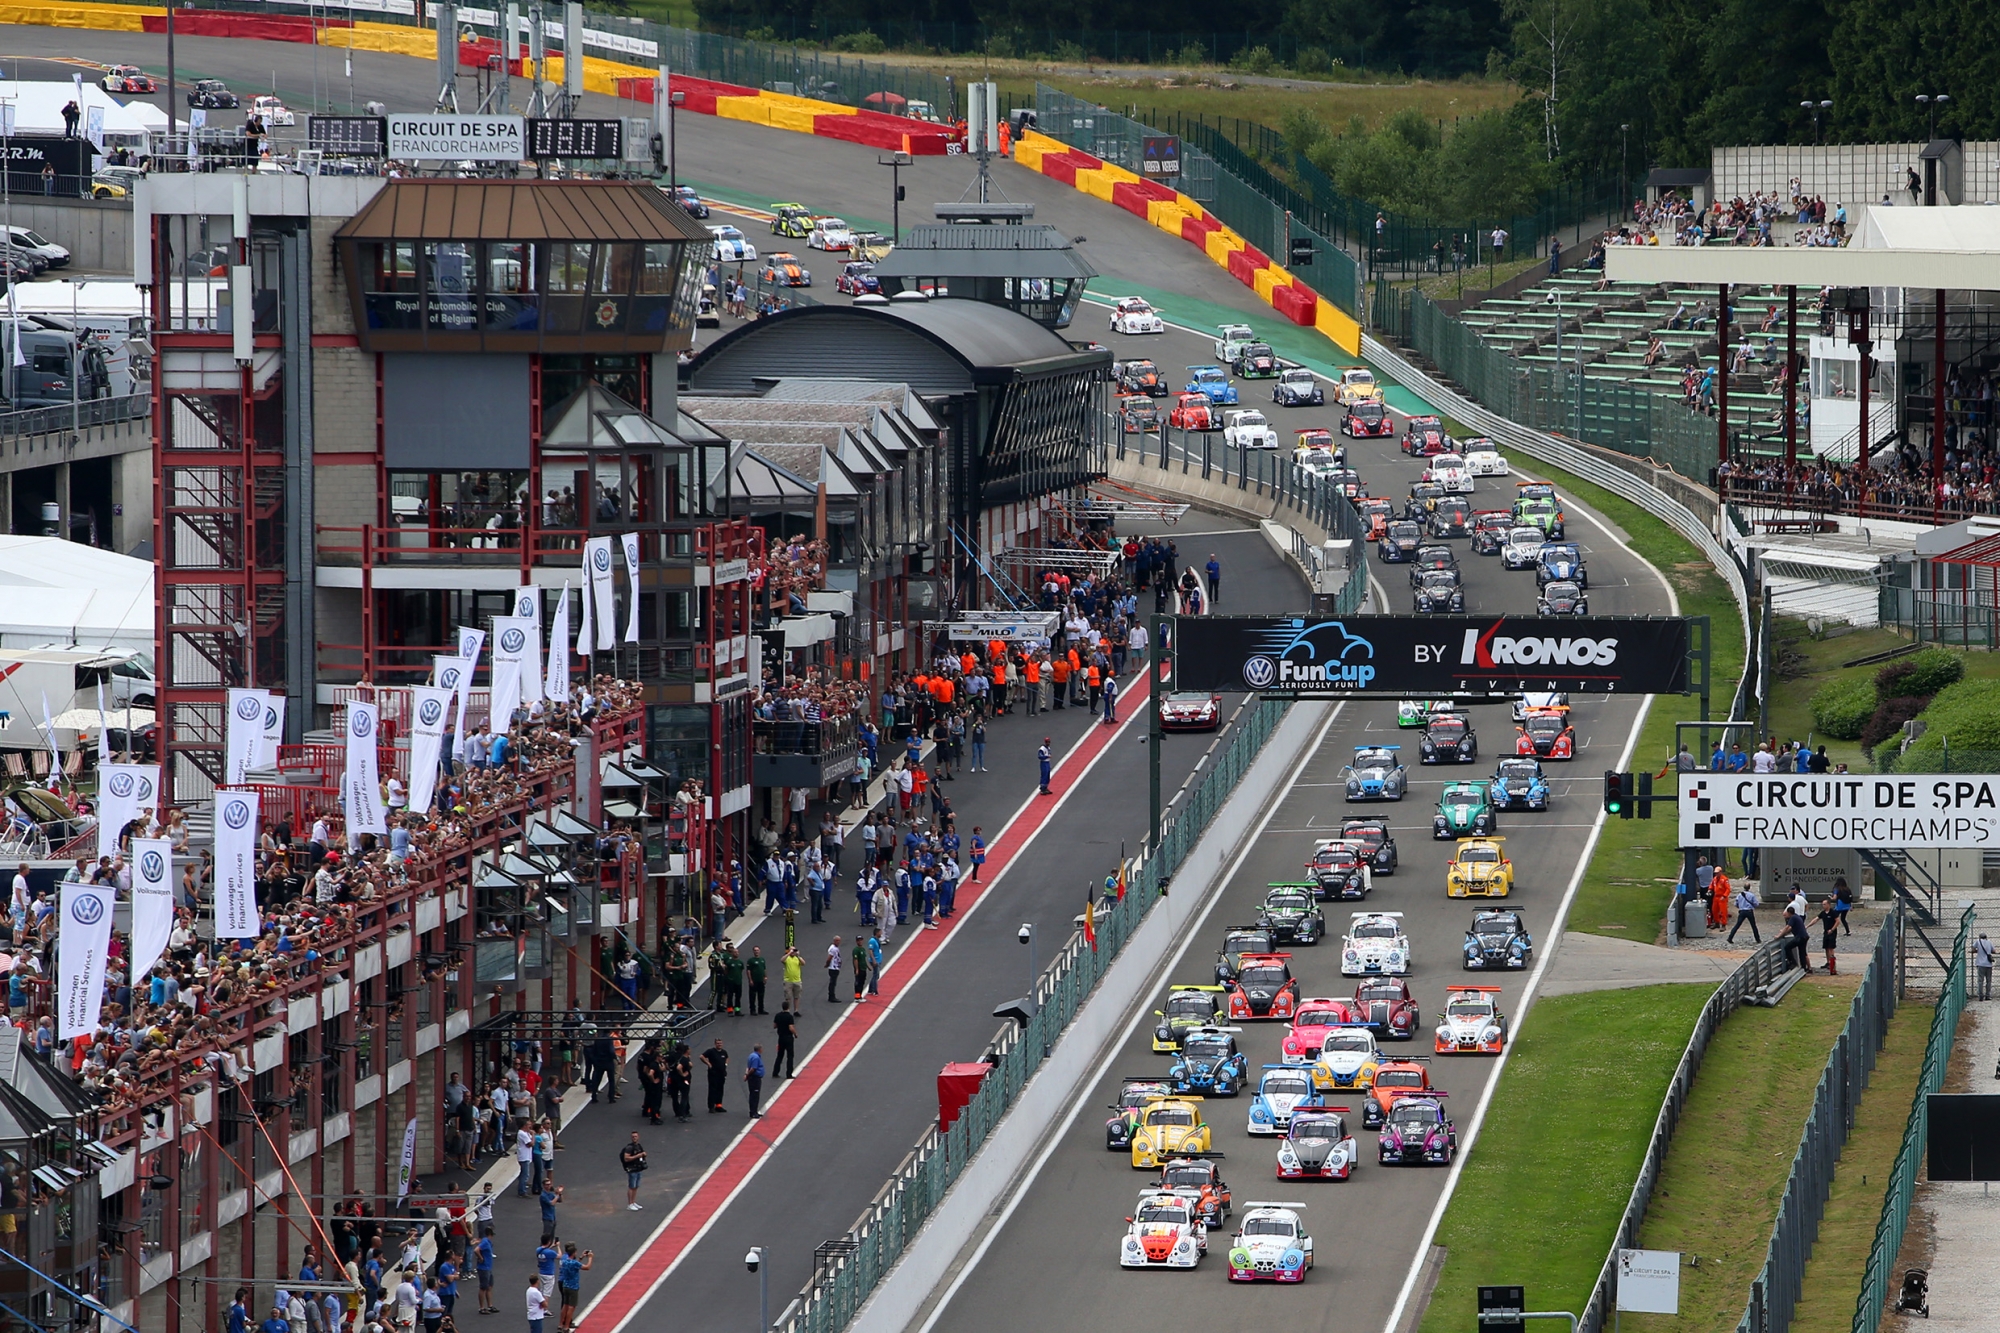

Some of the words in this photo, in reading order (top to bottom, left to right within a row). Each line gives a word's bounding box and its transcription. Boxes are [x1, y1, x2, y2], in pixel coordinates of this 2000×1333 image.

[392, 122, 455, 136] CIRCUIT
[461, 123, 482, 136] DE
[486, 123, 519, 138] SPA
[535, 121, 618, 155] 08.07
[393, 140, 520, 153] FRANCORCHAMPS
[947, 145, 962, 155] SC
[395, 301, 420, 313] Royal
[428, 301, 478, 312] Automobile
[486, 302, 506, 312] Club
[429, 314, 439, 324] of
[441, 313, 477, 325] Belgium
[1415, 645, 1446, 662] BY
[1460, 618, 1618, 669] KRONOS
[1280, 660, 1375, 688] FunCup
[1280, 681, 1331, 689] SERIOUSLY
[1335, 681, 1358, 689] FUN!
[353, 781, 364, 826] Volkswagen
[1736, 781, 1863, 808] CIRCUIT
[1874, 782, 1915, 808] DE
[1932, 782, 1996, 811] SPA
[1735, 817, 1990, 842] FRANCORCHAMPS
[136, 887, 171, 897] Volkswagen
[238, 890, 246, 930] Financial
[81, 949, 93, 986] Services
[68, 974, 79, 1030] Volkswagen
[78, 990, 88, 1028] Financial
